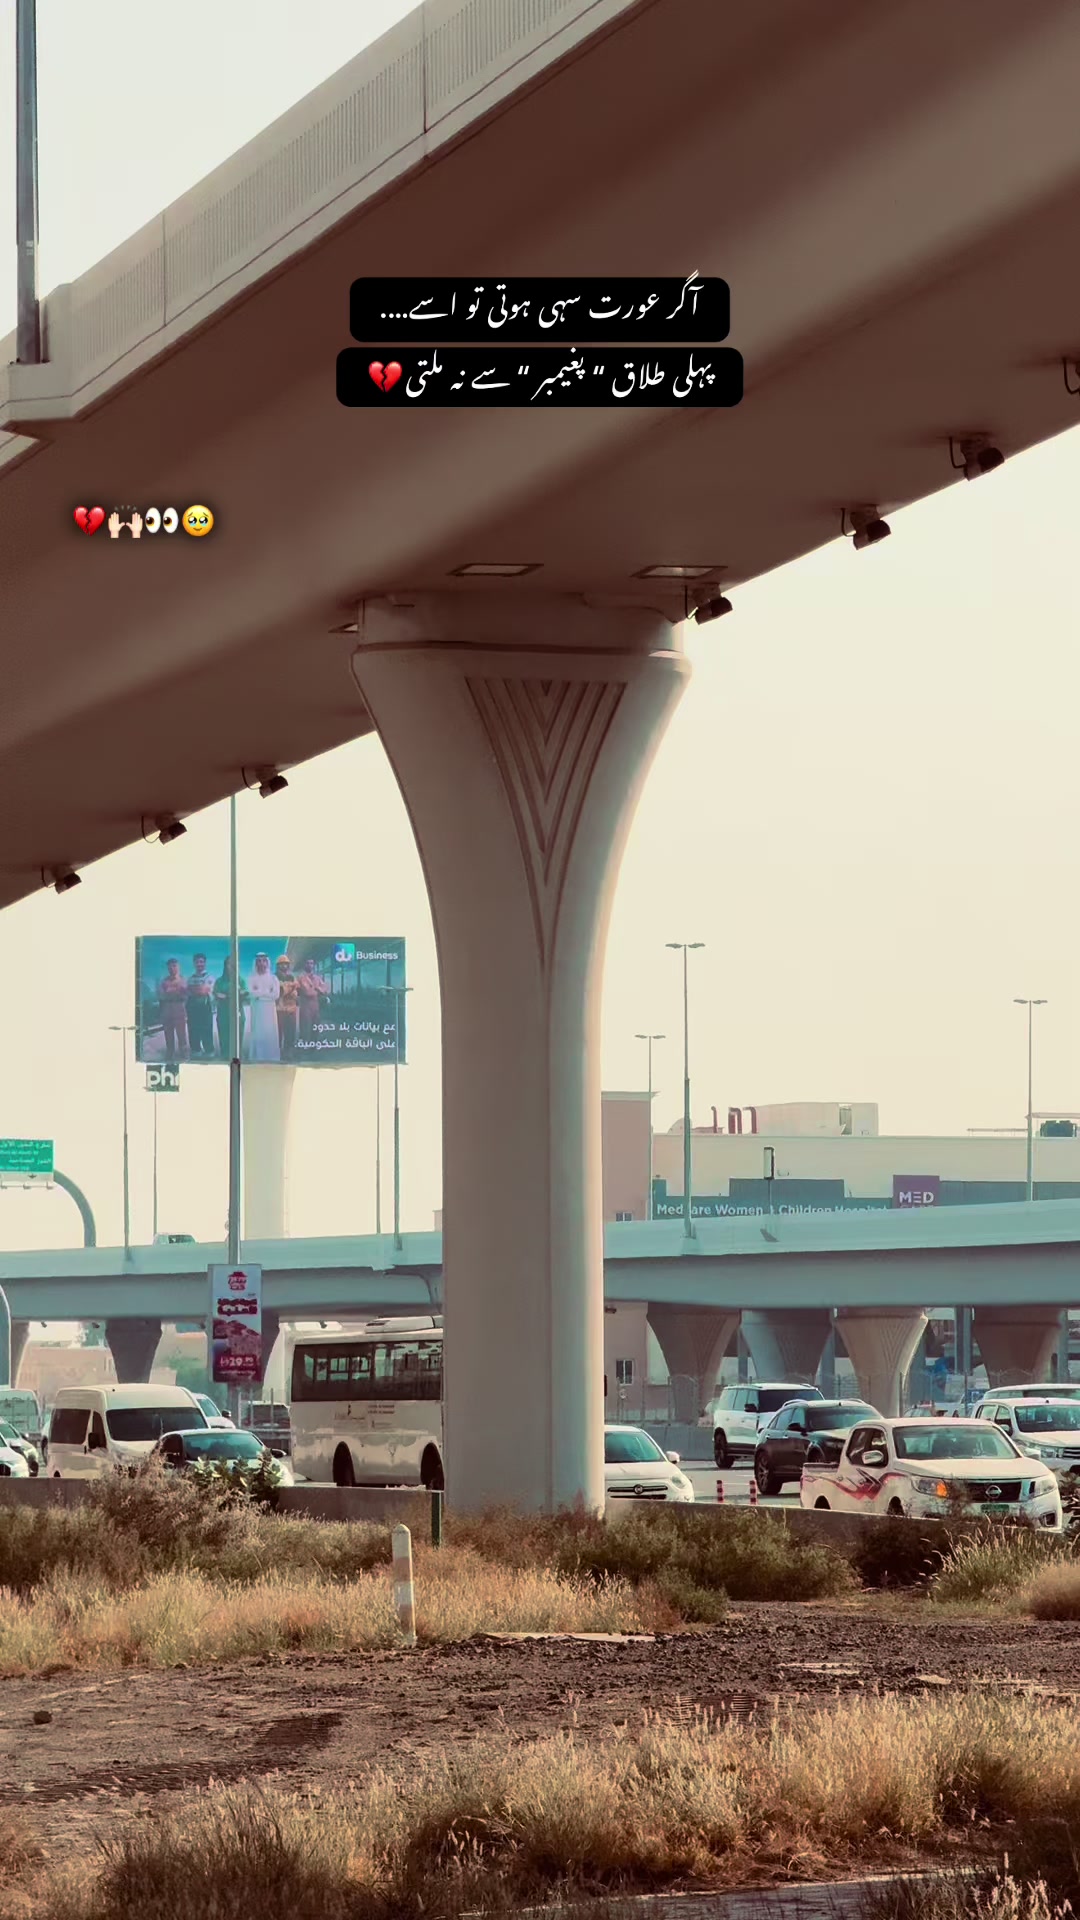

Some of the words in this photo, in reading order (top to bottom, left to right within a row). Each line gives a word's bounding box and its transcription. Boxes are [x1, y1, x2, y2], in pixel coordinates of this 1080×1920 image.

[334, 948, 353, 962] du
[356, 950, 399, 960] Business
[312, 1023, 336, 1033] حدود
[353, 1021, 380, 1034] بيانات
[345, 1036, 373, 1050] الباقة
[376, 1039, 396, 1050] على
[899, 1191, 935, 1204] MED
[714, 1203, 764, 1216] Women
